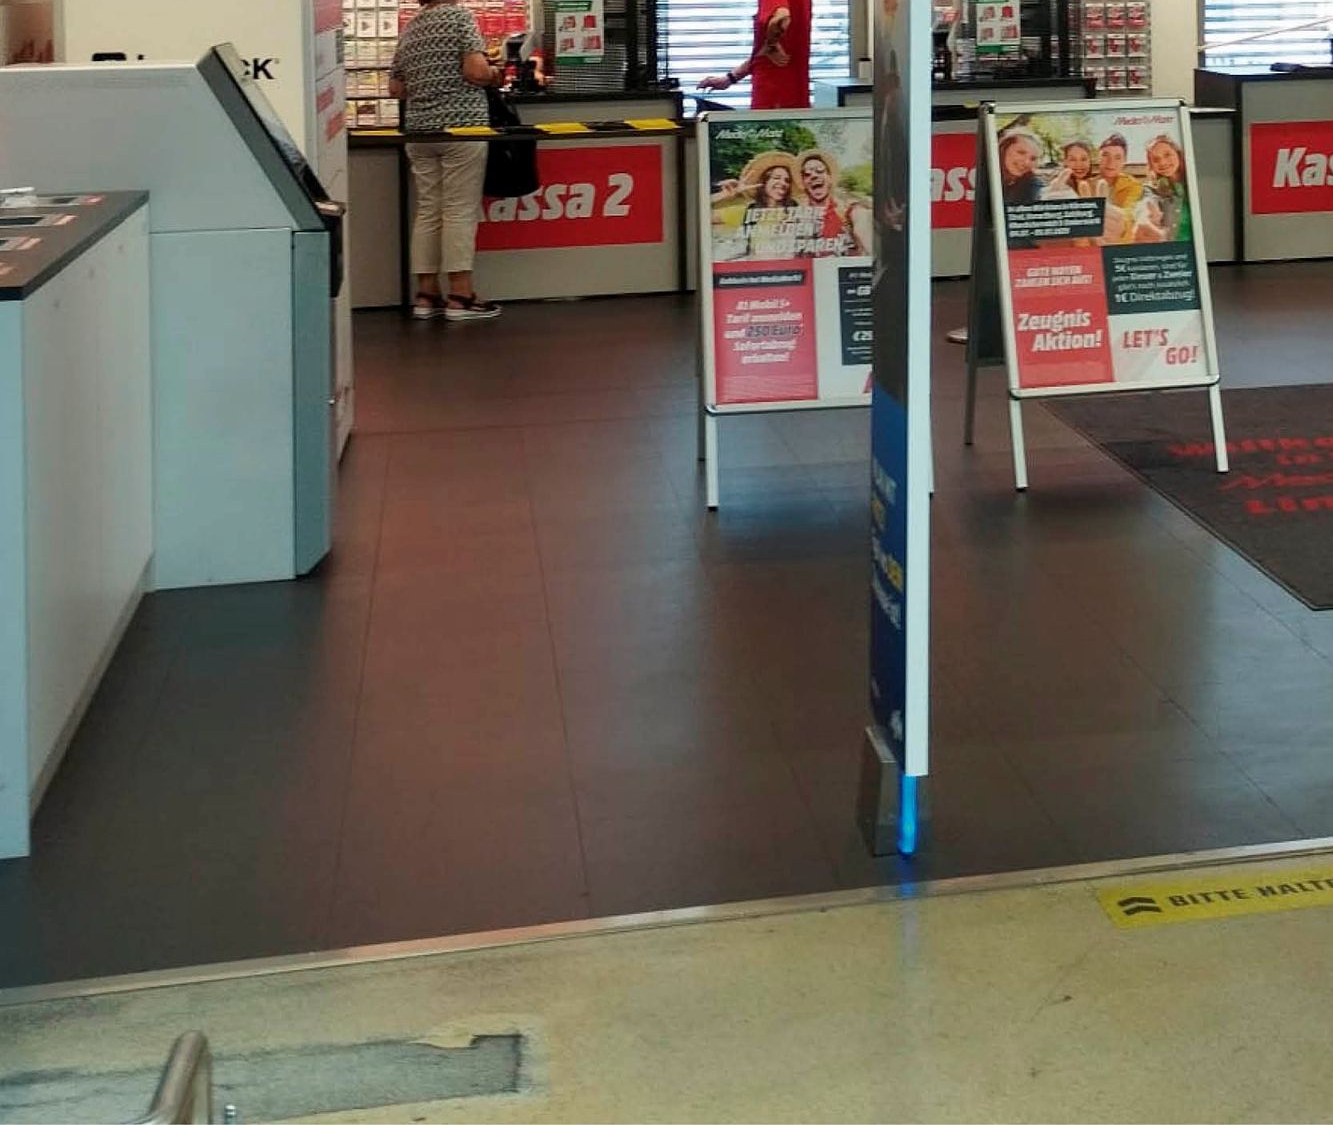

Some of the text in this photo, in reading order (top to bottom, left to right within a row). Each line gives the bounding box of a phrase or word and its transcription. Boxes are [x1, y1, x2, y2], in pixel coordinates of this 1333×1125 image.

[485, 173, 634, 222] assa 2
[1018, 309, 1091, 332] Zeugnis
[1032, 329, 1103, 352] Aktion!
[1123, 329, 1169, 348] LET'S
[1166, 346, 1199, 365] GO!
[1168, 888, 1249, 908] BITTE
